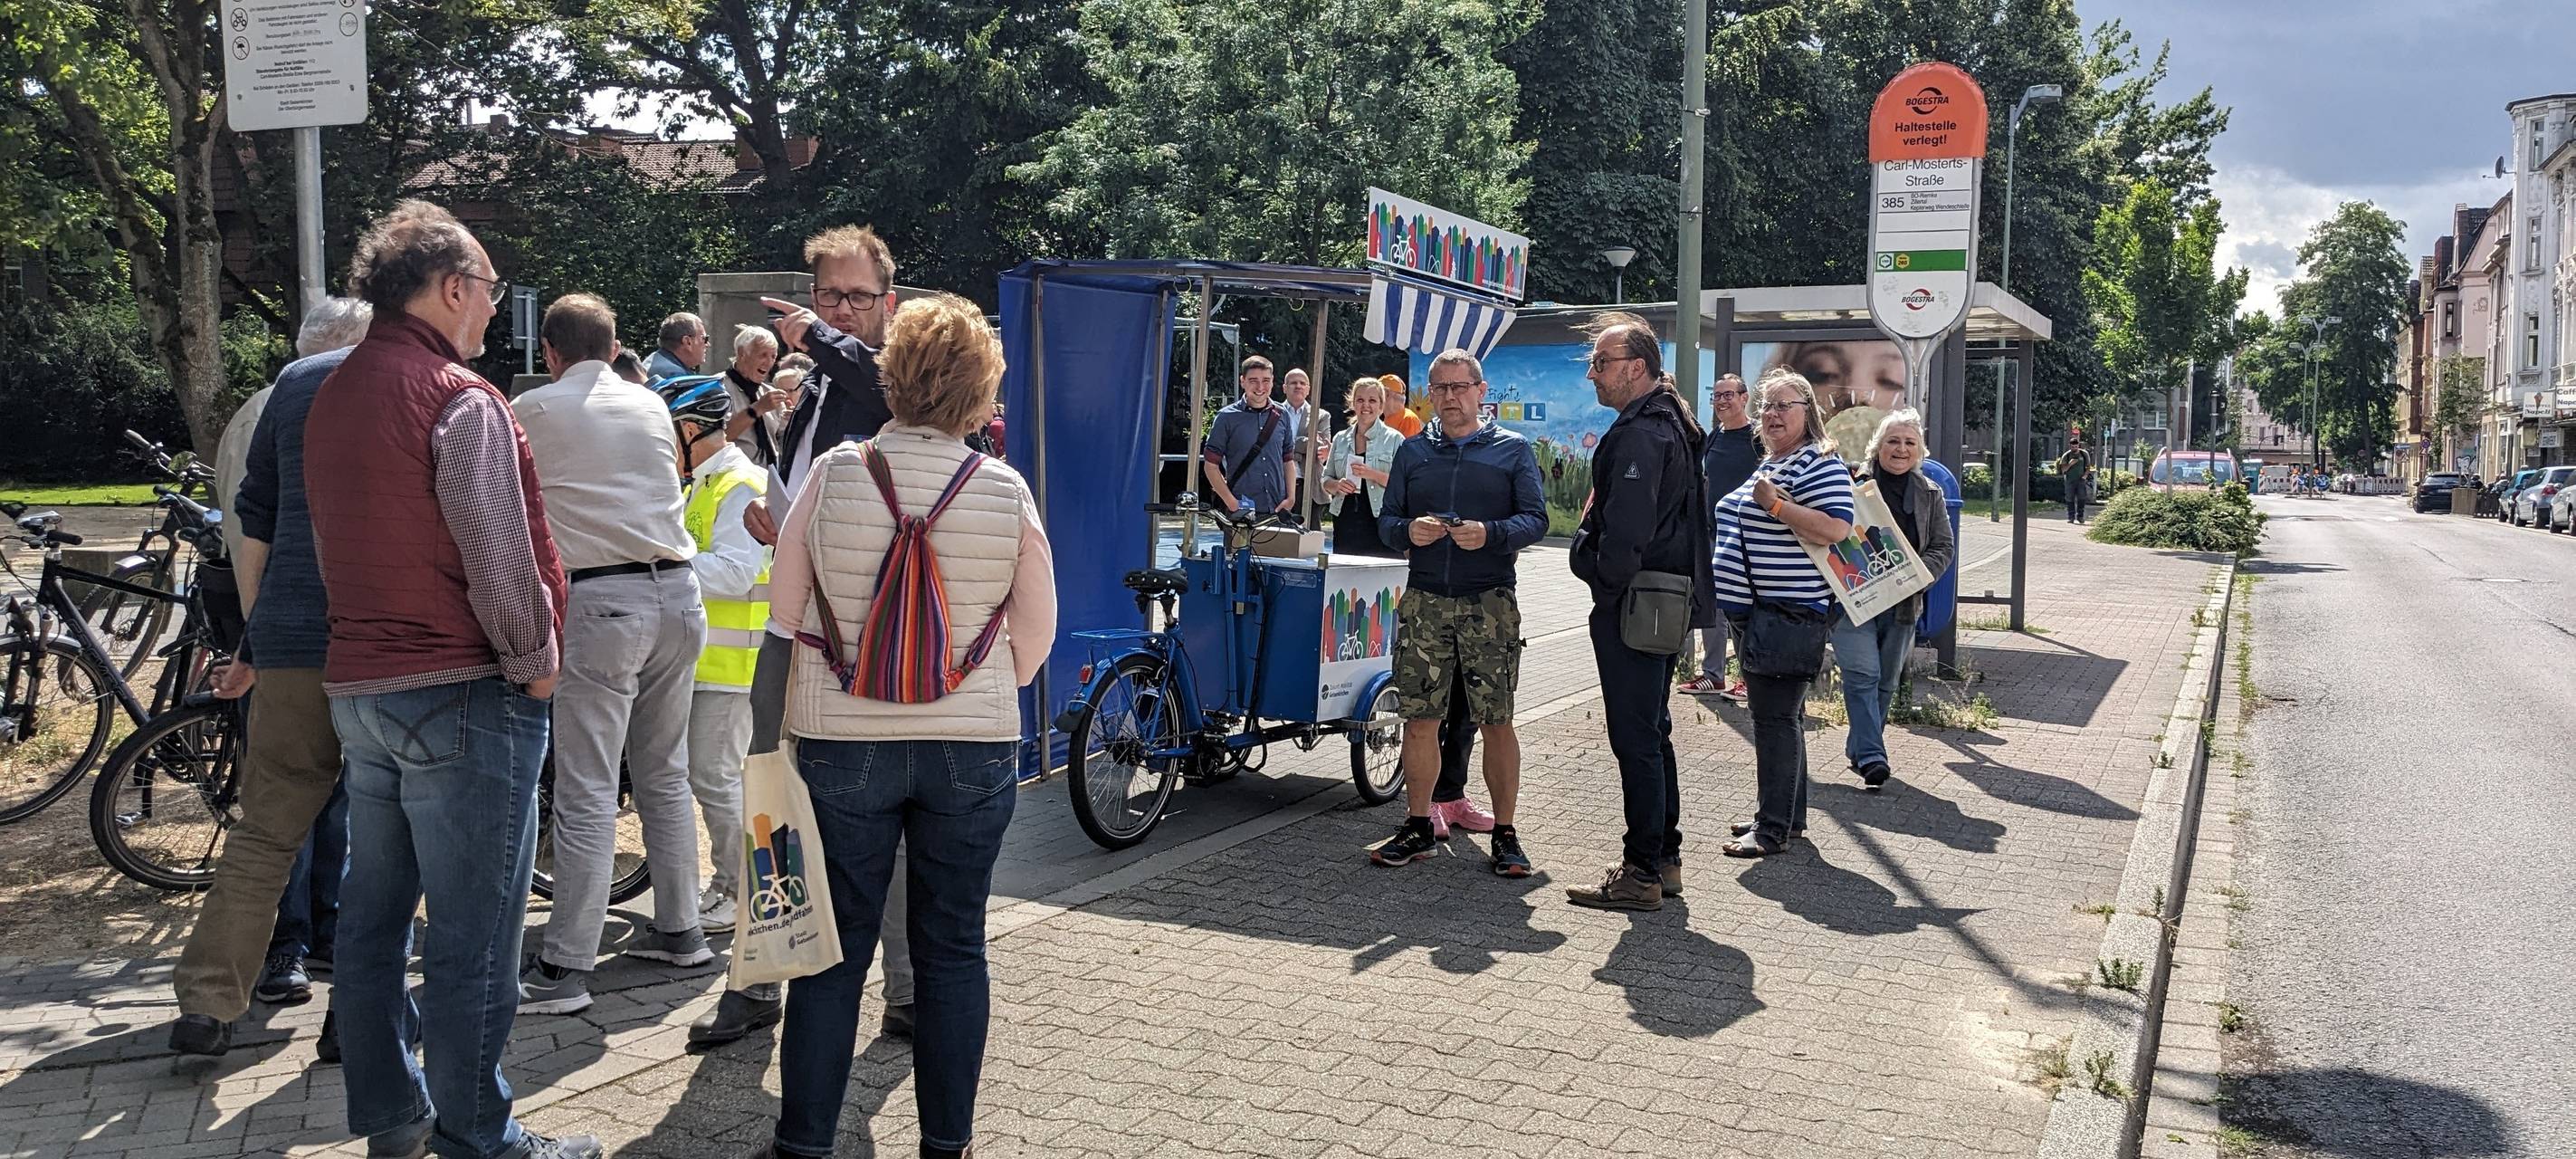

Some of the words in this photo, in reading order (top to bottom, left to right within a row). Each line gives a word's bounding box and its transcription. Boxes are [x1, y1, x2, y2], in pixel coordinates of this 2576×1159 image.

[1905, 96, 1949, 106] BOGESTRA
[1894, 120, 1957, 132] Haltestelle
[1903, 135, 1947, 147] verlegt!
[1884, 158, 1968, 171] Carl-Mosterts-
[1905, 174, 1944, 187] Straße
[1882, 196, 1904, 208] 385
